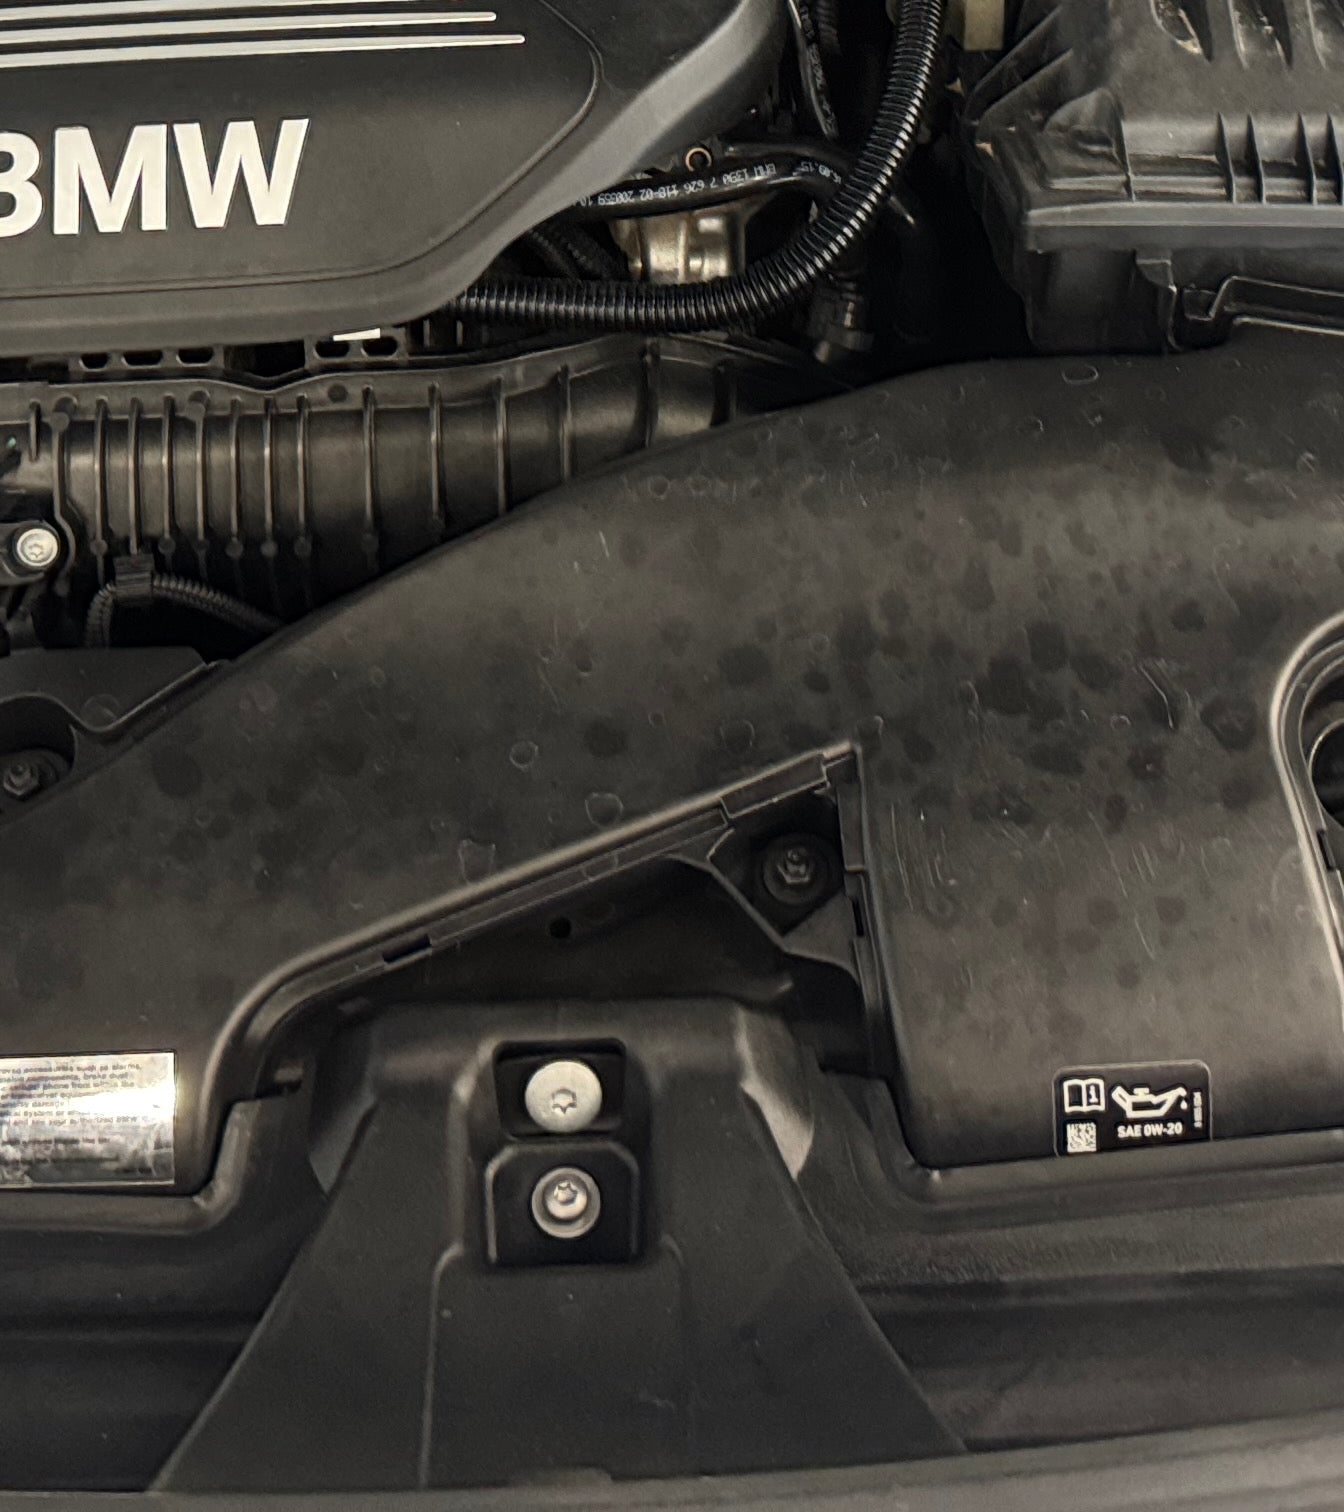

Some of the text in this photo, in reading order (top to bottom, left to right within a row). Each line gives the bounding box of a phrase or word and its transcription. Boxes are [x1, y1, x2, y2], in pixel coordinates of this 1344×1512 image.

[684, 179, 705, 194] 626
[1117, 1121, 1183, 1138] SAE 0W-20
